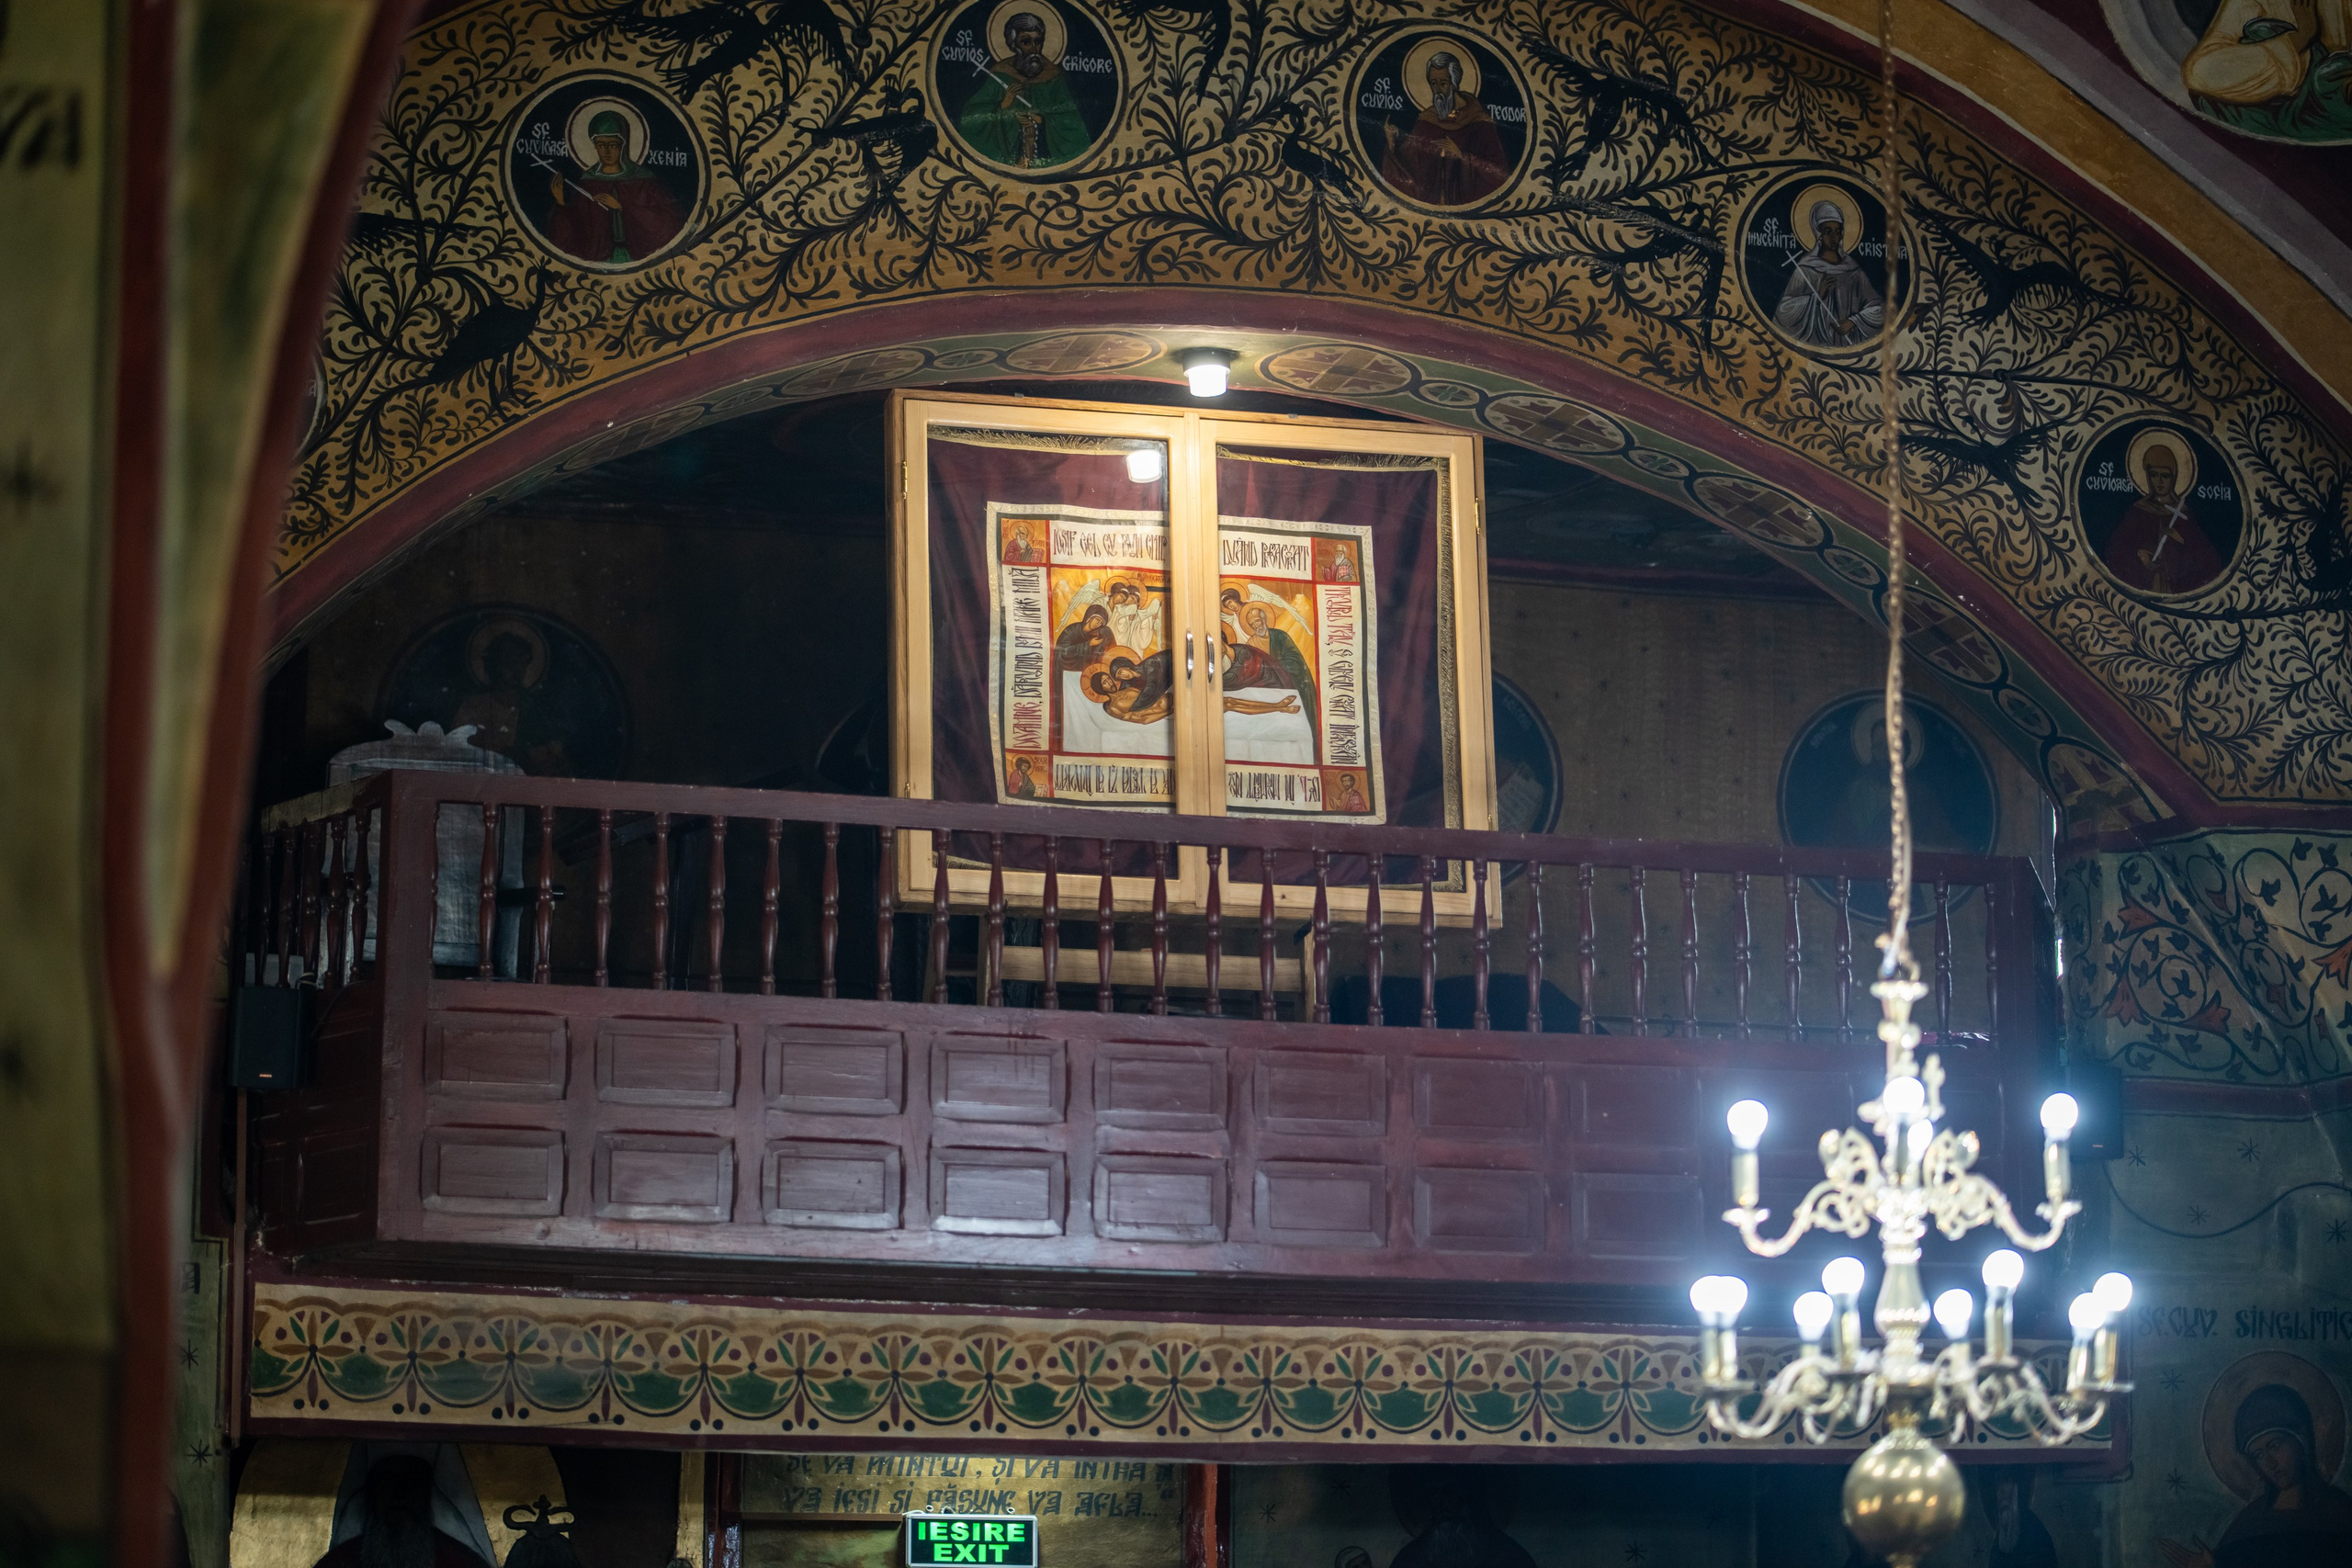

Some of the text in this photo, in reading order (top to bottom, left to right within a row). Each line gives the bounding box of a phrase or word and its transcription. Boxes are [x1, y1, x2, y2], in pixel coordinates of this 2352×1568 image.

[1062, 51, 1113, 73] GRIGORE
[1361, 94, 1527, 123] CUVIOS TEODOR
[648, 147, 687, 167] XENIA
[1858, 237, 1907, 260] CRISTA
[2197, 482, 2232, 501] SOFIA
[1027, 1489, 1062, 1517] VA
[918, 1521, 1025, 1542] IESIRE
[933, 1542, 1010, 1562] EXIT
